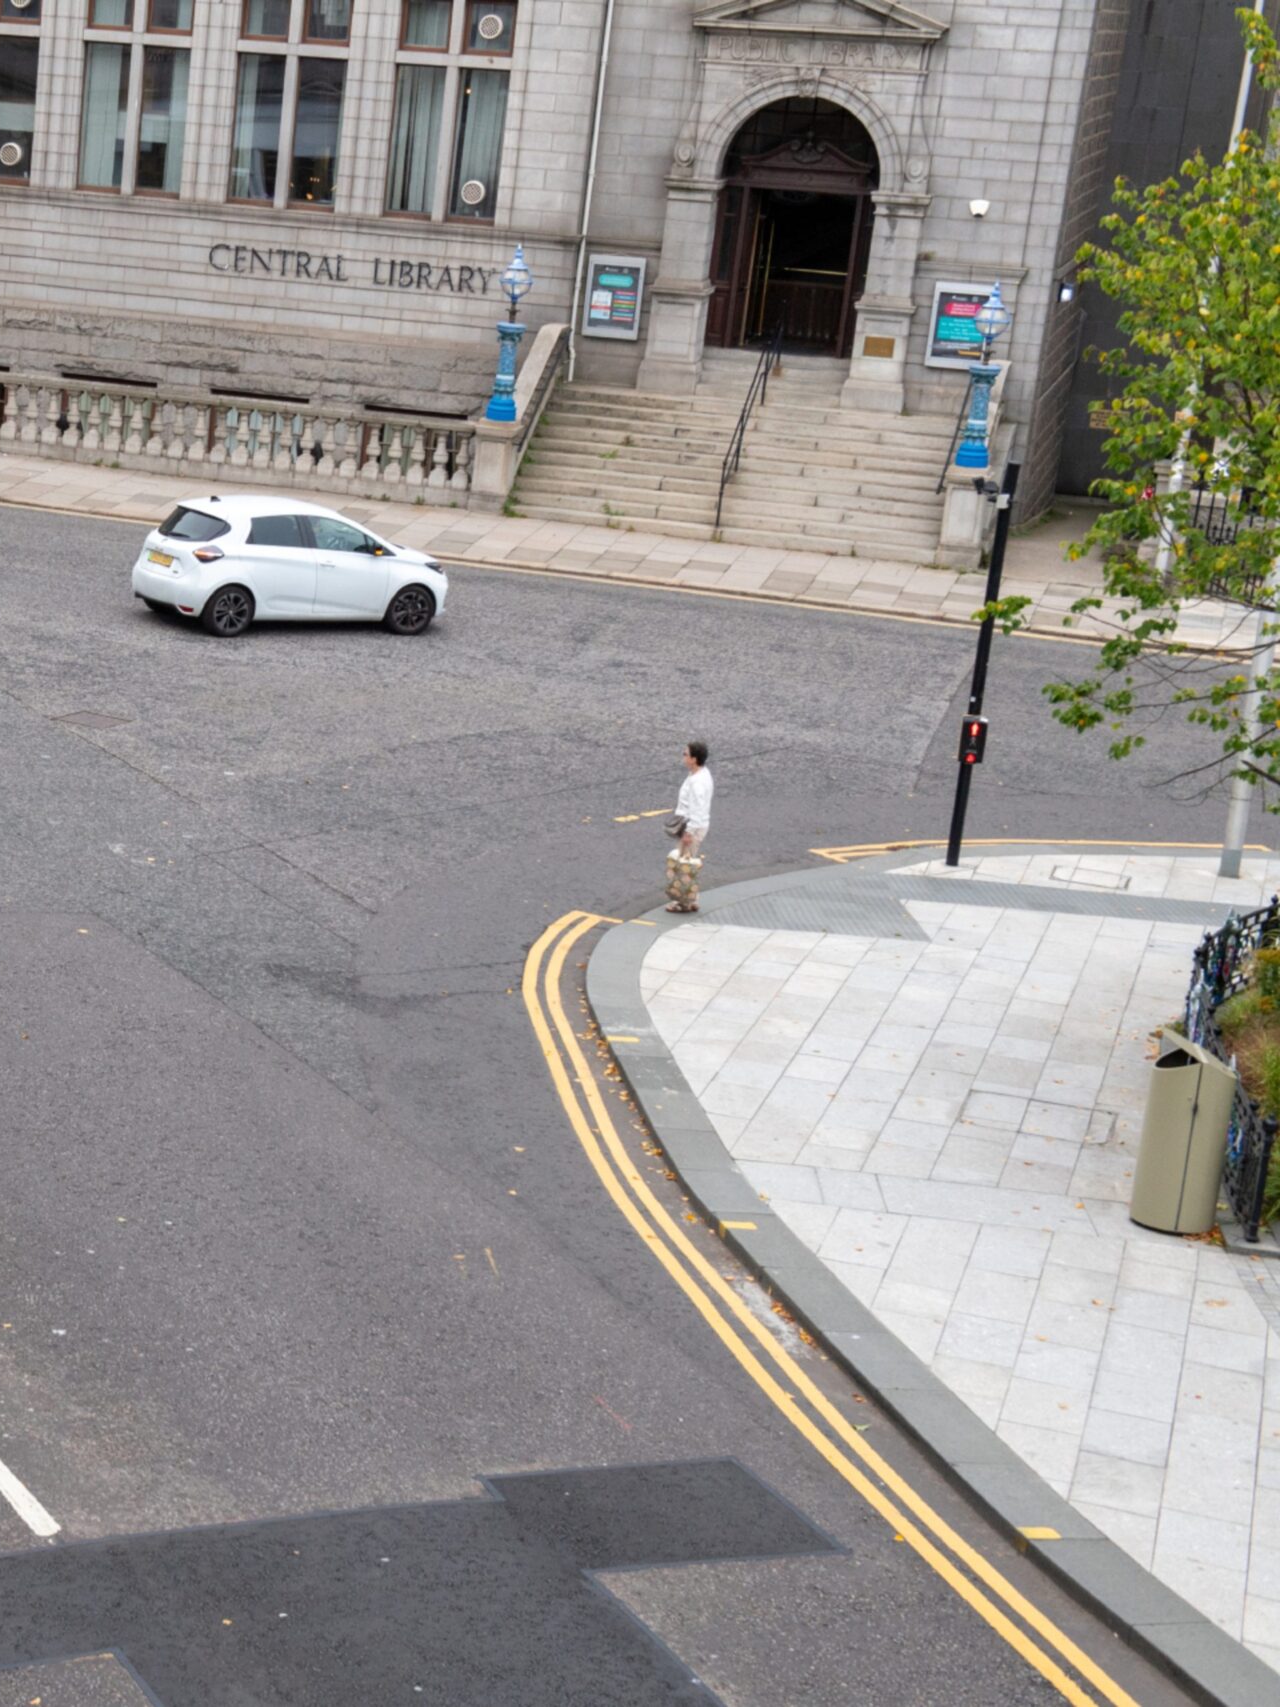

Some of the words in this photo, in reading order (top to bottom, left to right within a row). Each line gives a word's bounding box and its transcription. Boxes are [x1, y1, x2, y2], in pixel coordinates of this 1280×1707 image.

[718, 35, 797, 63] PUBLIC
[809, 40, 913, 67] LIBRARY
[209, 243, 348, 282] CENTRAL
[373, 257, 496, 295] LIBRARY
